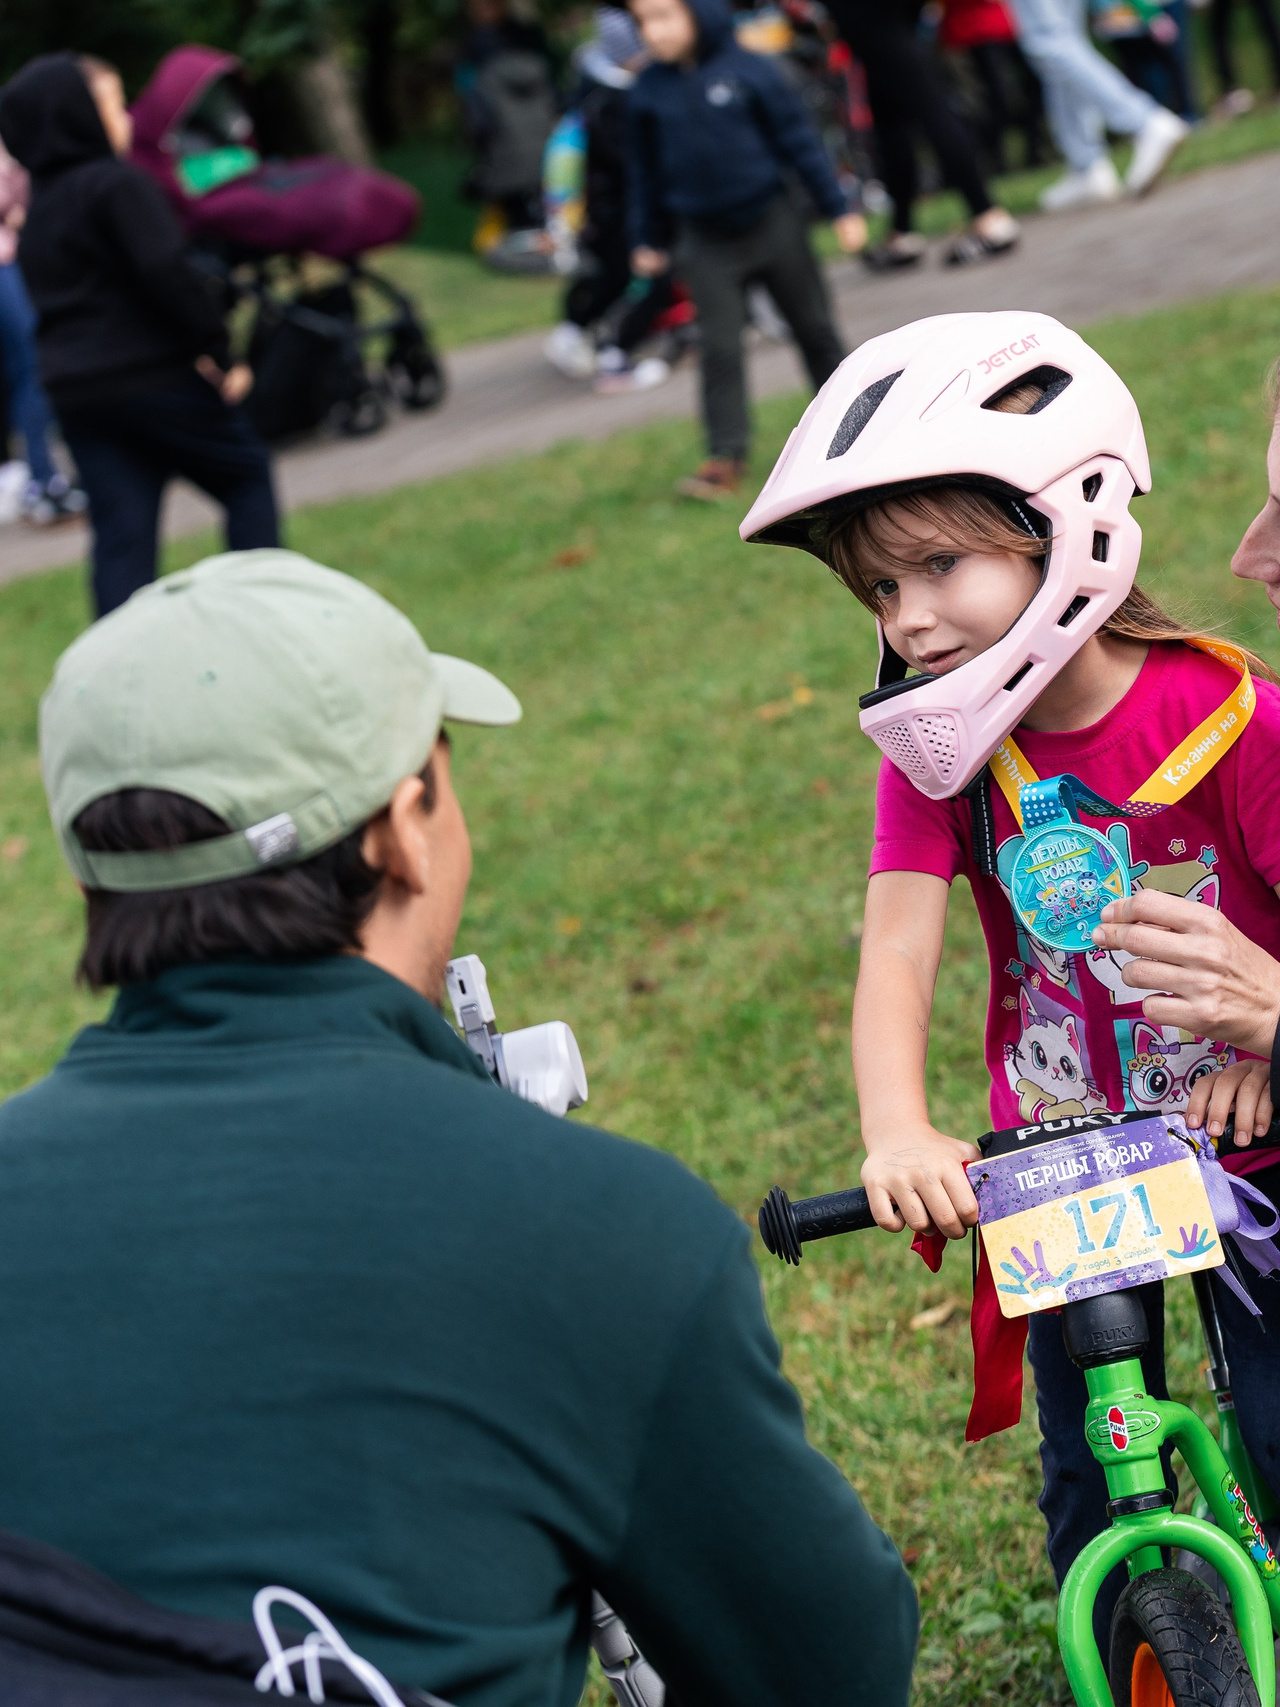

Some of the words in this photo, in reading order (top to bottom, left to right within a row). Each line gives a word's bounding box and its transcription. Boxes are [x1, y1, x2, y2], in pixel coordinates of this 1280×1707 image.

[977, 333, 1041, 375] JETCAT
[1162, 729, 1222, 786] Каханне
[1219, 712, 1238, 733] на
[1029, 837, 1082, 866] ПЕРШЫ
[1041, 857, 1083, 882] РОВАР
[1016, 1113, 1129, 1141] PUKY
[1015, 1155, 1092, 1192] ПЕРШЫ
[1093, 1141, 1153, 1171] РОВАР
[1064, 1183, 1161, 1254] 171
[1092, 1325, 1136, 1345] PUKY
[1109, 1422, 1126, 1434] PUKY
